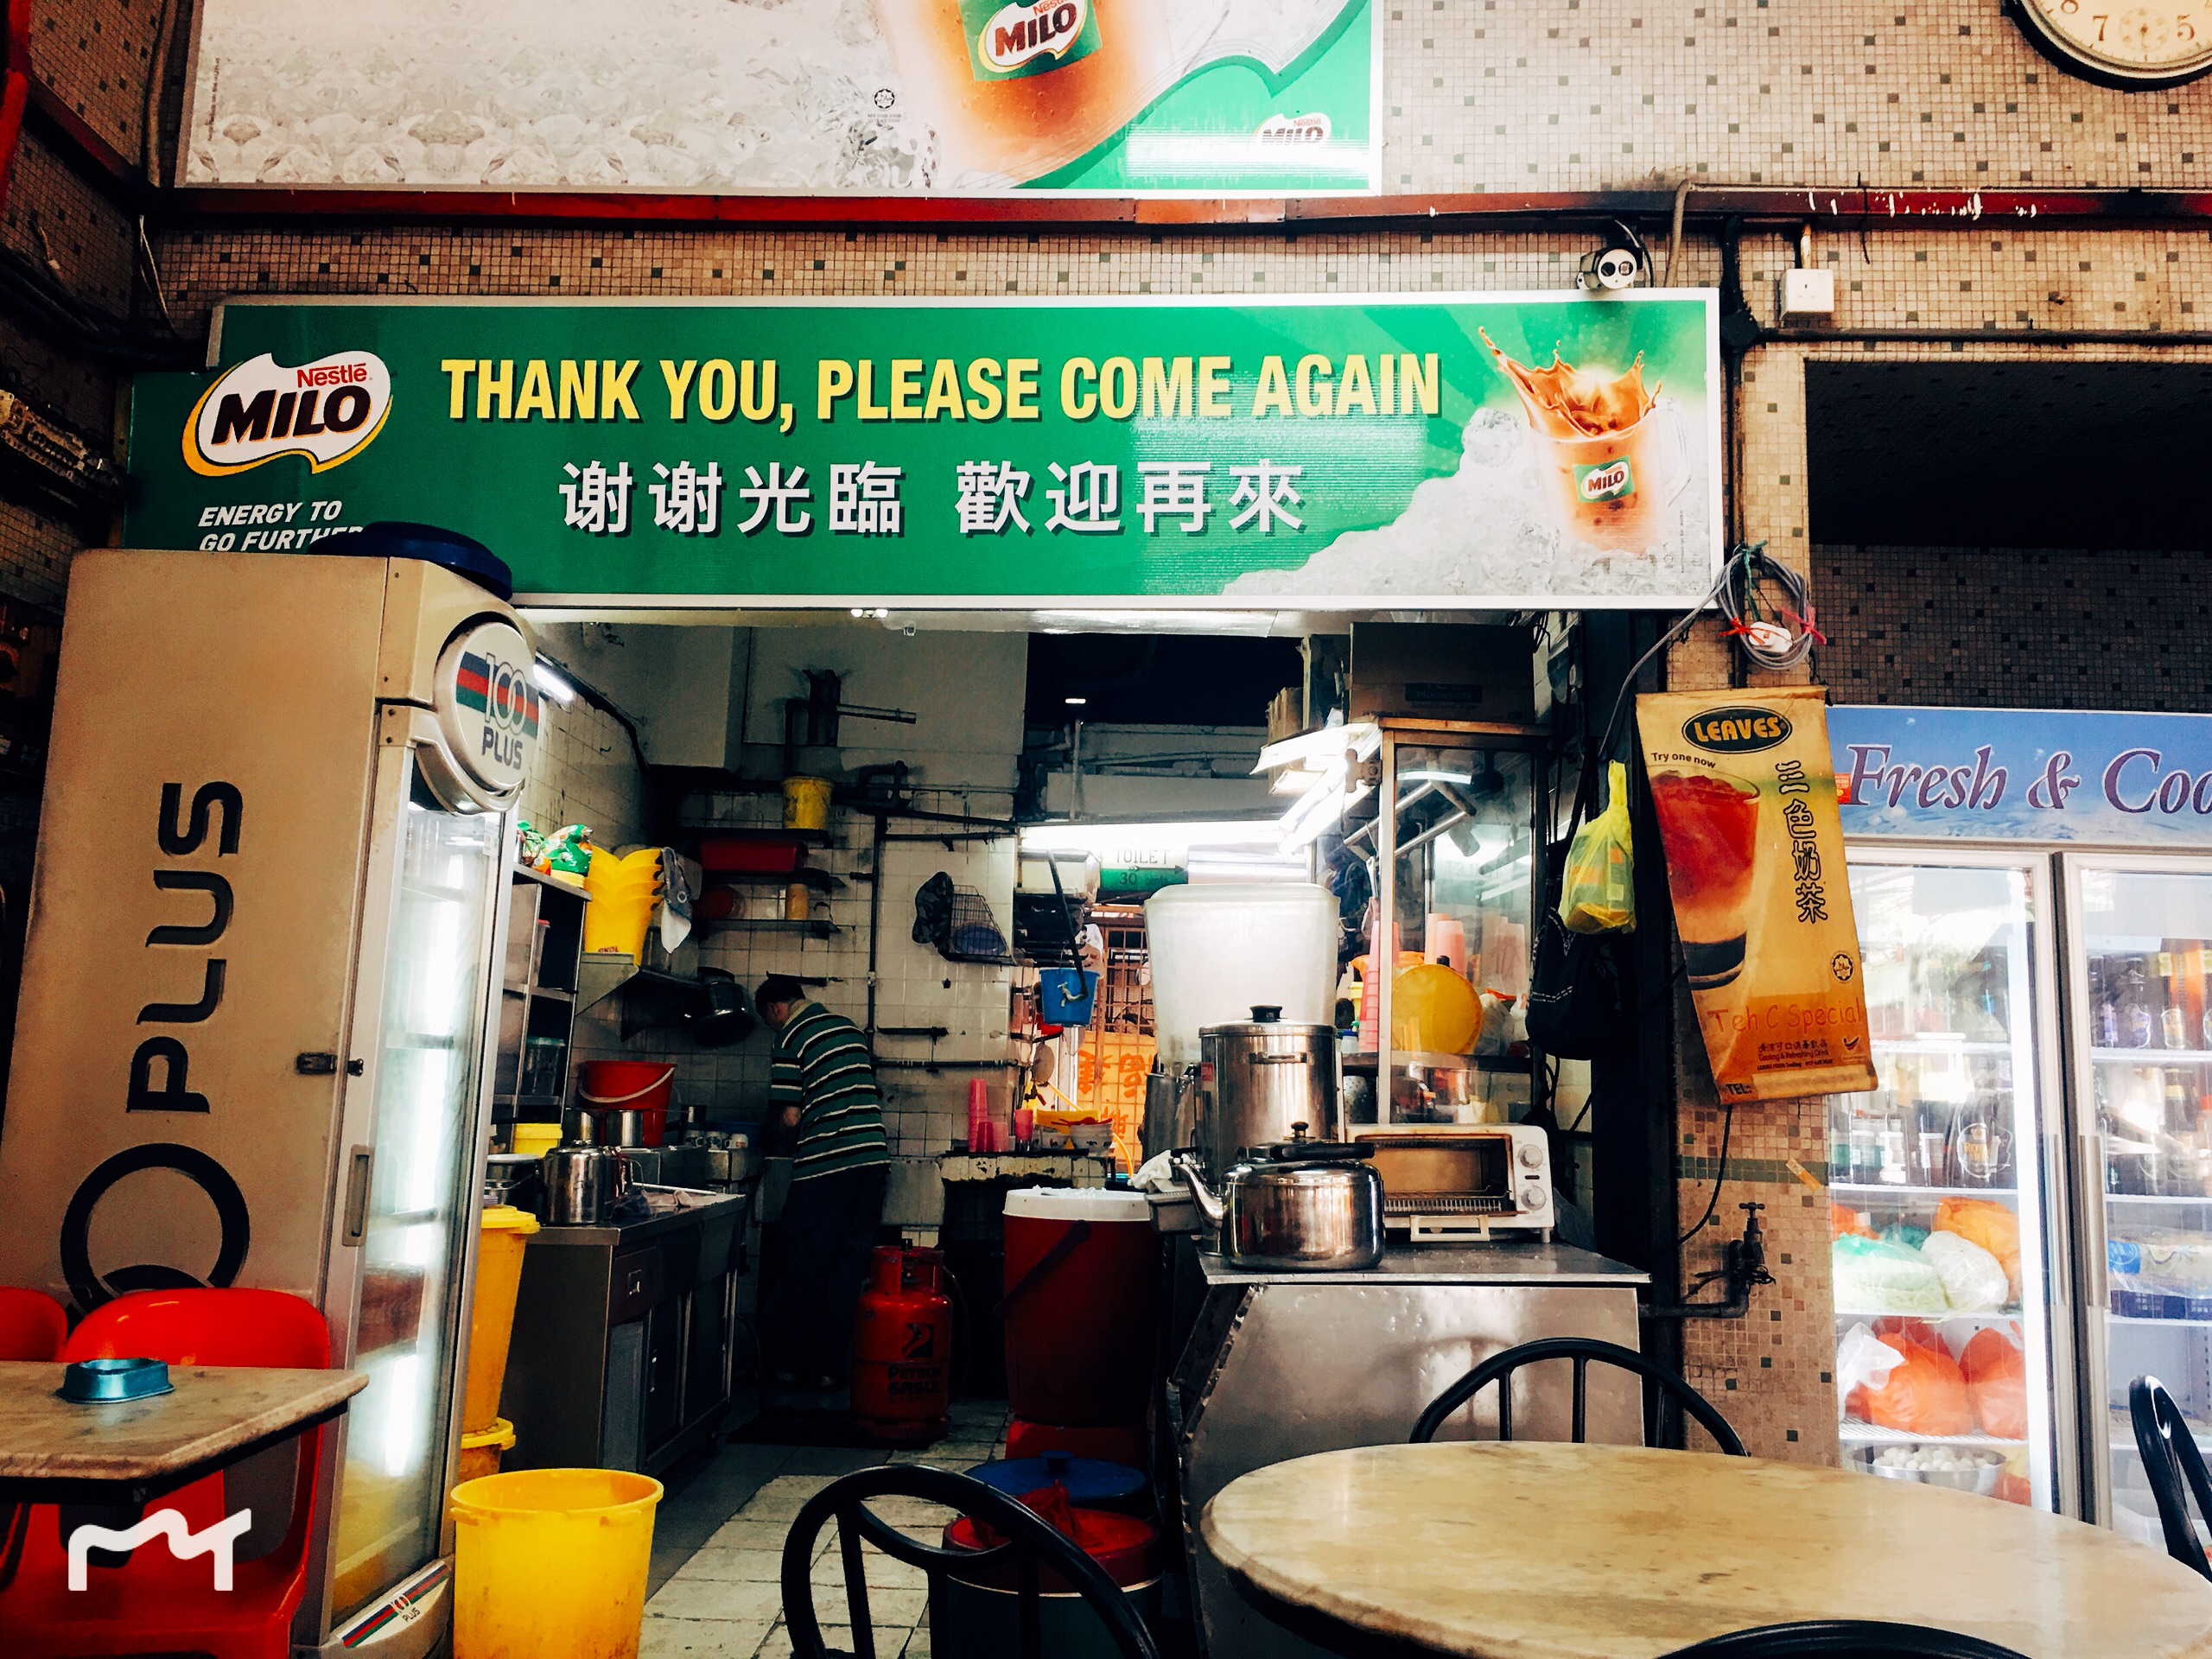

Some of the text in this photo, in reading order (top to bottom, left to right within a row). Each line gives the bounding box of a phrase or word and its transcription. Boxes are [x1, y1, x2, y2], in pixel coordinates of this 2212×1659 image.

[995, 3, 1077, 56] MILO
[2092, 15, 2108, 41] 7
[2177, 13, 2196, 41] 5
[442, 353, 1441, 434] THANK YOU, PLEASE COME AGAIN
[211, 385, 372, 446] MILO
[1587, 470, 1624, 492] MILO
[558, 457, 1306, 537] 谢谢光臨 歡迎再來
[198, 499, 343, 527] ENERGY TO
[199, 532, 237, 551] GO
[484, 652, 528, 735] 100
[1694, 715, 1783, 742] LEAVES
[481, 726, 524, 771] PLUS
[1651, 752, 1716, 769] Try one now
[1846, 742, 2009, 810] Fresh
[2026, 749, 2081, 810] &
[1775, 760, 1828, 925] 三色奶茶
[1114, 849, 1170, 865] TOILET
[1119, 872, 1138, 886] 30
[125, 779, 244, 1114] PLUS
[1707, 997, 1862, 1035] Teh C Special
[1725, 1083, 1752, 1096] TEL:
[402, 1606, 421, 1623] PLUS
